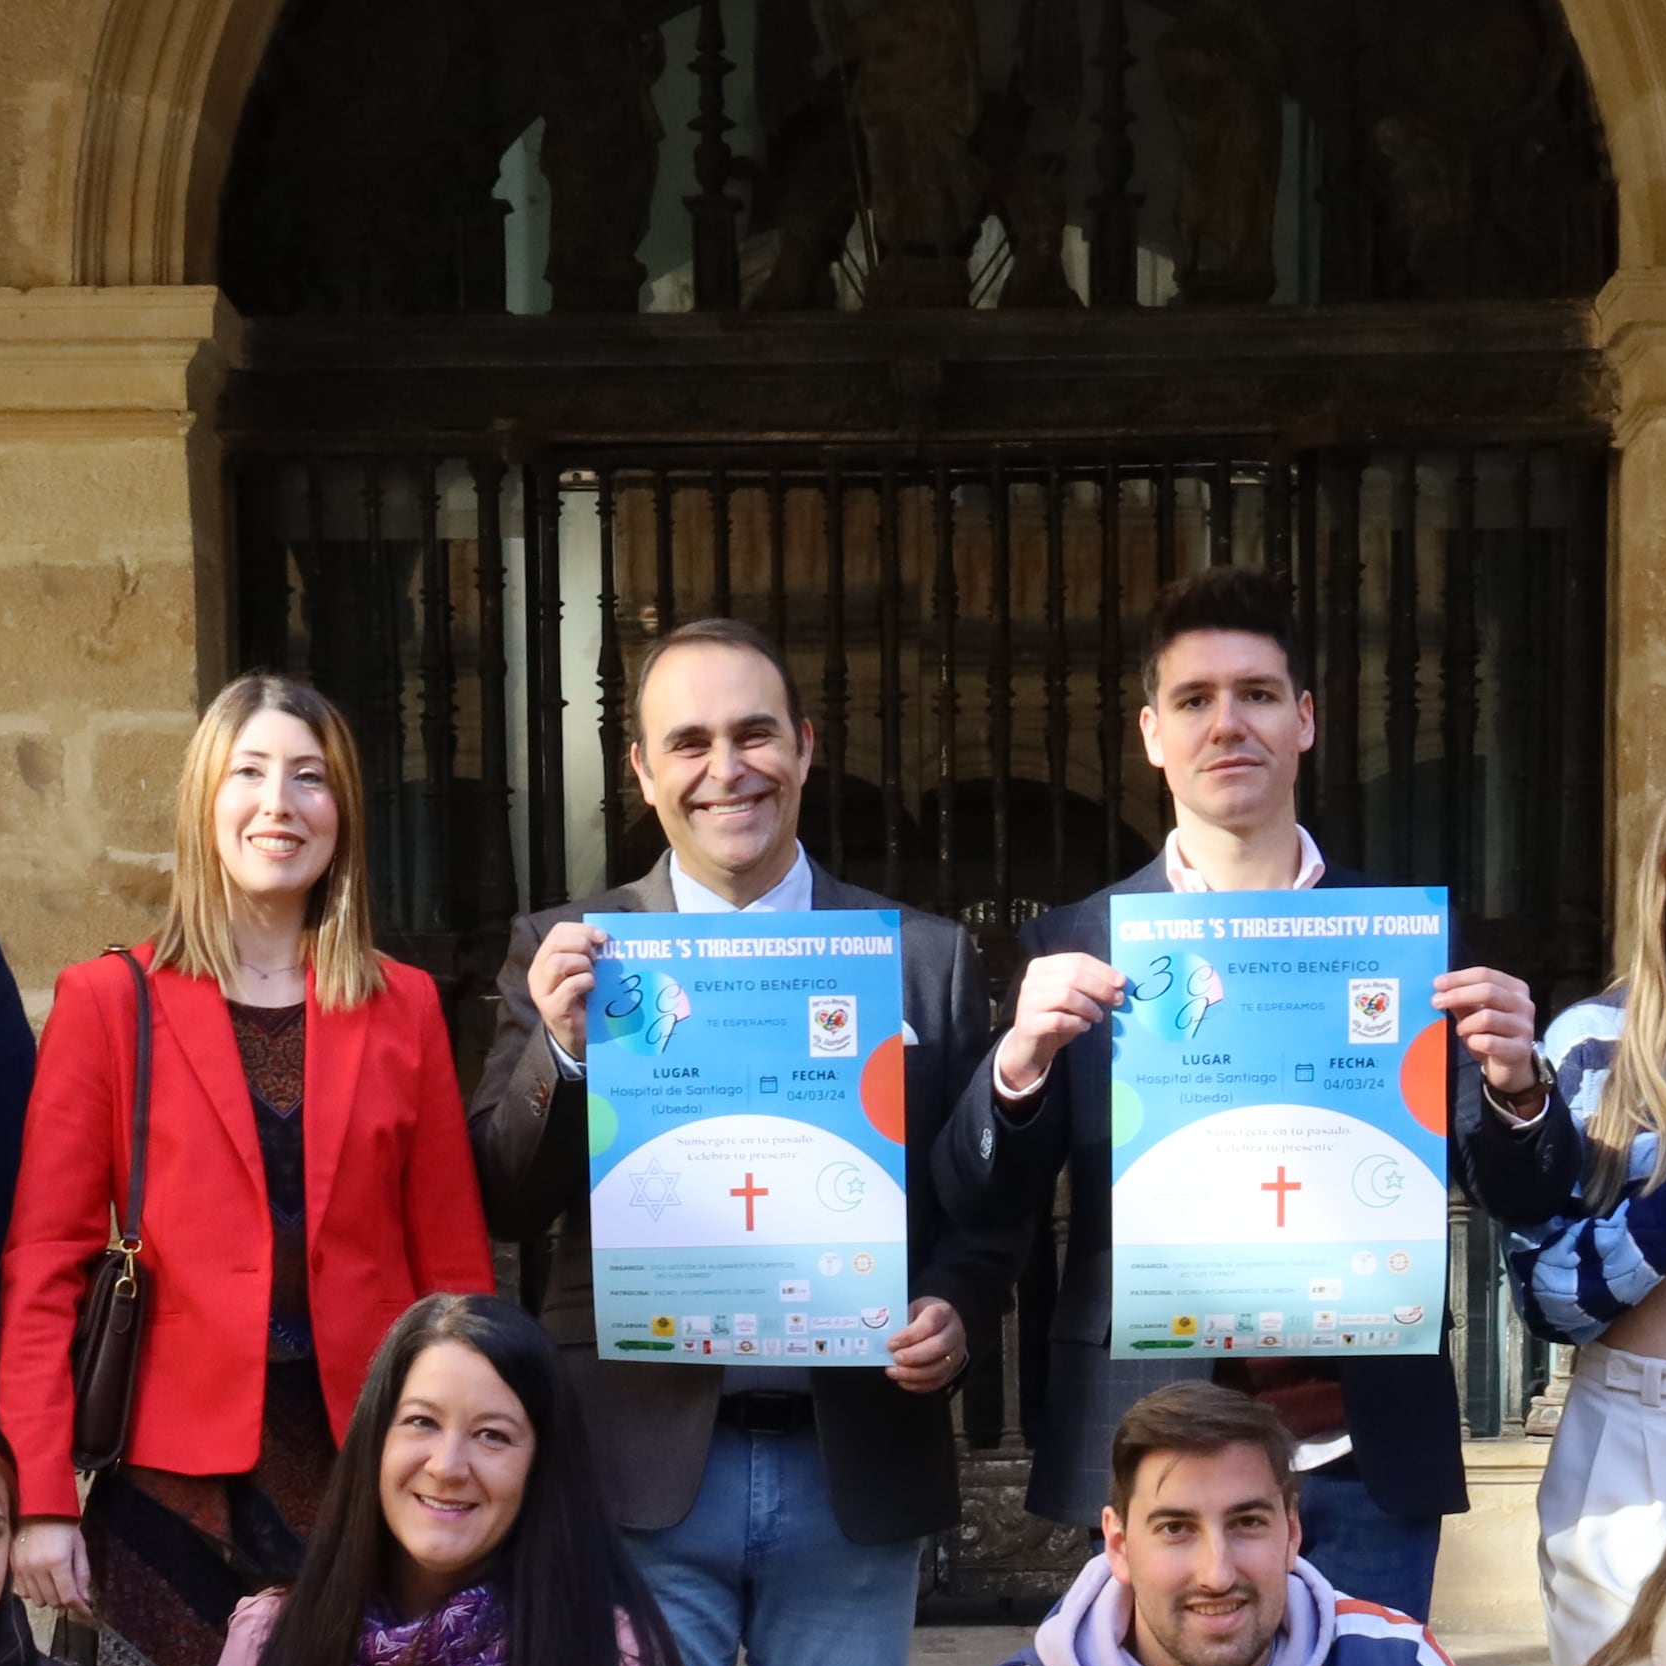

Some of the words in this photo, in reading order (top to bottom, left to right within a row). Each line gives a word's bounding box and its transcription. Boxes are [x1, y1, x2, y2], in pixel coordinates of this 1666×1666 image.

[1120, 919, 1204, 941] CULTURE
[1230, 916, 1368, 938] THREEVERSITY
[1373, 915, 1439, 936] FORUM
[696, 937, 826, 958] THREEVERSITY
[831, 936, 892, 955] FORUM
[1228, 962, 1291, 974] EVENTO
[1298, 960, 1379, 973] BENÉFICO
[695, 980, 755, 992] EVENTO
[761, 978, 837, 990] BENÉFICO
[1241, 1003, 1254, 1012] TE
[1257, 1003, 1325, 1011] ESPERAMOS
[708, 1019, 719, 1027] TE
[723, 1018, 787, 1027] ESPERAMOS
[1183, 1054, 1231, 1065] LUGAR
[1330, 1058, 1379, 1069] FECHA:
[653, 1068, 699, 1079] LUGAR
[792, 1070, 839, 1081] FECHA:
[1137, 1073, 1192, 1085] Hospital
[1197, 1073, 1212, 1084] de
[1217, 1073, 1277, 1086] Santiago
[1324, 1078, 1384, 1090] 04/03/24
[611, 1085, 662, 1098] Hospital
[667, 1086, 681, 1096] de
[686, 1084, 743, 1097] Santiago
[787, 1090, 845, 1101] 04/03/24
[1266, 1144, 1278, 1152] tu
[687, 1152, 730, 1161] Celebra
[735, 1152, 746, 1160] tu
